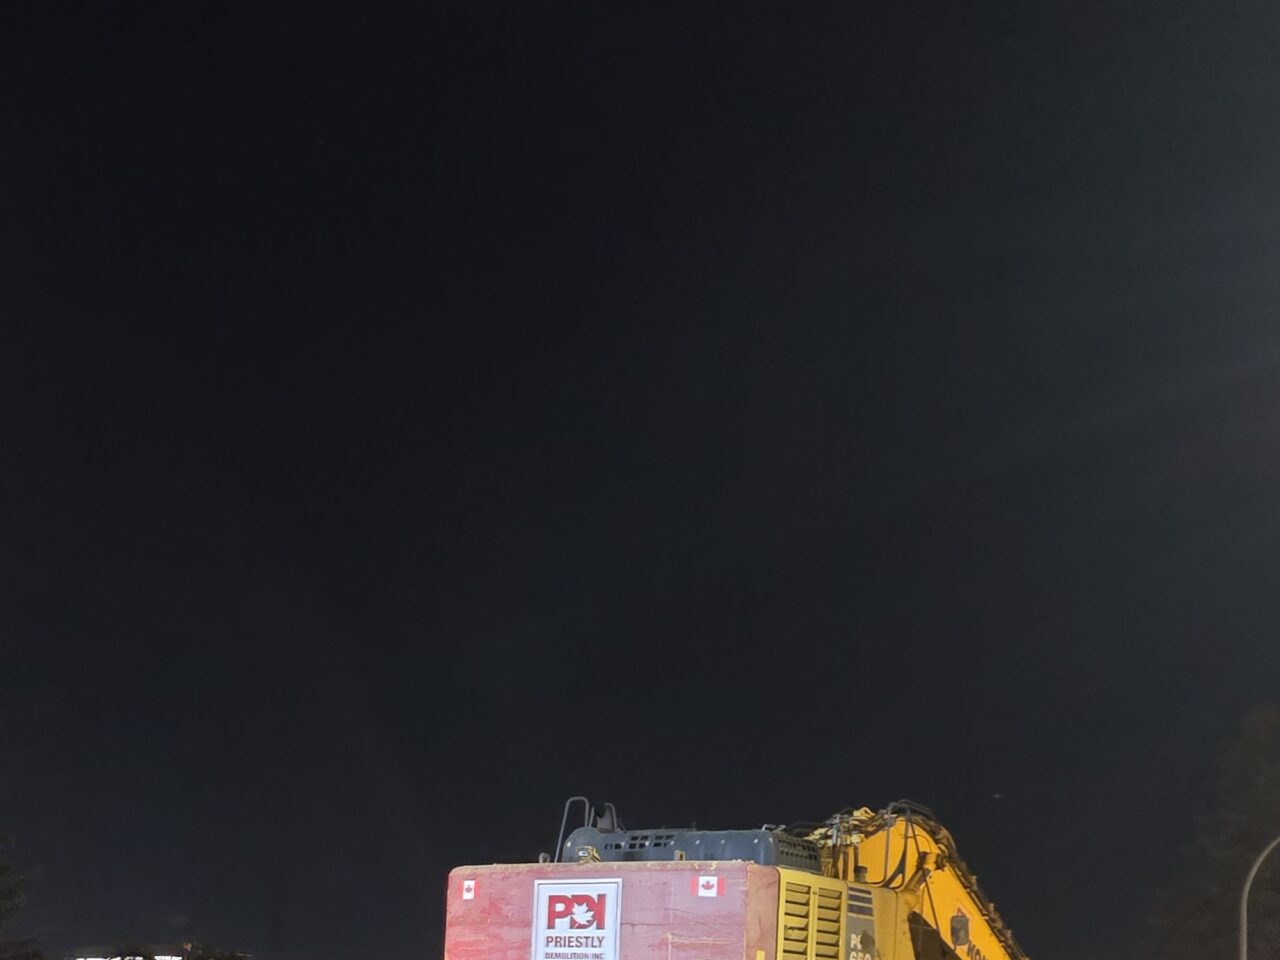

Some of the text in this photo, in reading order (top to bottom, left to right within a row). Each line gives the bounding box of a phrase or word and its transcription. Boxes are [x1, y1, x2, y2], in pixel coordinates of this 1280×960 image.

[547, 893, 607, 930] PDI
[545, 935, 605, 948] PRIESTLY
[545, 952, 589, 960] DEMOLITION
